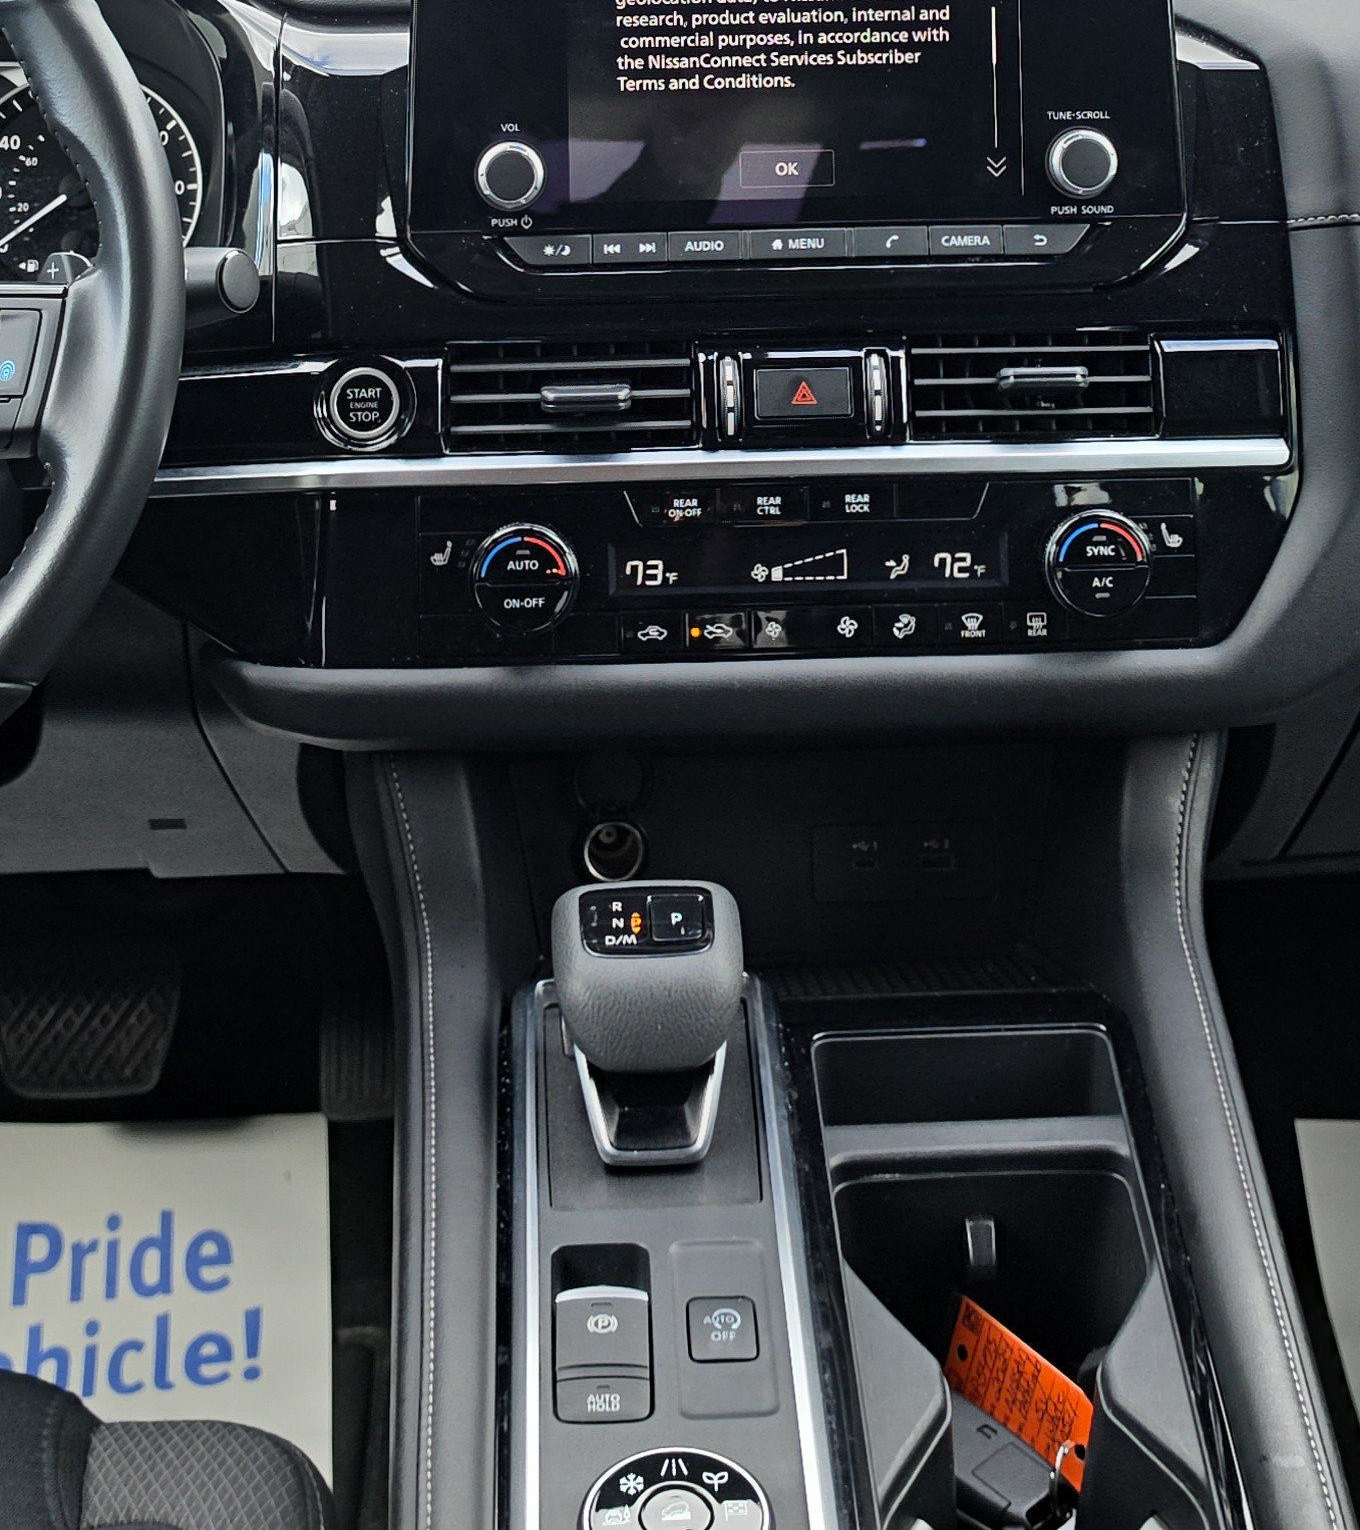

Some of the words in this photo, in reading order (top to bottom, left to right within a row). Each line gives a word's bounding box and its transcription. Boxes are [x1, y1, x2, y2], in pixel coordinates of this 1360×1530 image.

[616, 13, 688, 28] research,
[692, 11, 755, 28] product
[759, 8, 848, 24] evaluation,
[852, 7, 915, 21] internal
[919, 6, 950, 20] and
[620, 33, 713, 48] commercial
[718, 32, 794, 48] purposes,
[799, 31, 813, 44] in
[818, 30, 908, 43] accordance
[912, 28, 950, 42] with
[617, 55, 644, 69] the
[648, 53, 766, 68] NissanConnect
[770, 52, 833, 66] Services
[837, 50, 921, 64] Subscriber
[617, 77, 665, 91] Terms
[669, 76, 699, 89] and
[703, 74, 795, 88] Conditions.
[500, 122, 520, 132] VOL
[25, 157, 37, 166] 60
[775, 162, 798, 176] OK
[17, 203, 29, 212] 20
[1051, 206, 1077, 215] PUSH
[1081, 205, 1114, 214] SOUND
[491, 218, 518, 227] PUSH
[684, 240, 724, 252] AUDIO
[788, 238, 825, 250] MENU
[942, 235, 990, 247] CAMERA
[346, 388, 382, 399] START
[350, 401, 378, 409] ENGINE
[349, 411, 379, 422] STOP
[673, 498, 698, 508] REAR
[757, 497, 781, 506] REAR
[845, 494, 870, 503] REAR
[757, 506, 781, 515] CTRL
[845, 503, 870, 513] LOCK
[1085, 546, 1116, 557] SYNC
[507, 560, 539, 570] AUTO
[1092, 576, 1113, 588] A/C
[961, 629, 985, 638] FRONT
[1027, 628, 1047, 636] REAR
[612, 902, 622, 911] R
[612, 918, 624, 928] N
[671, 912, 682, 926] P
[605, 934, 637, 945] D/M
[11, 1209, 233, 1305] Pride
[711, 1331, 736, 1341] OFF
[587, 1394, 620, 1403] AUTO
[588, 1402, 620, 1411] HOLD
